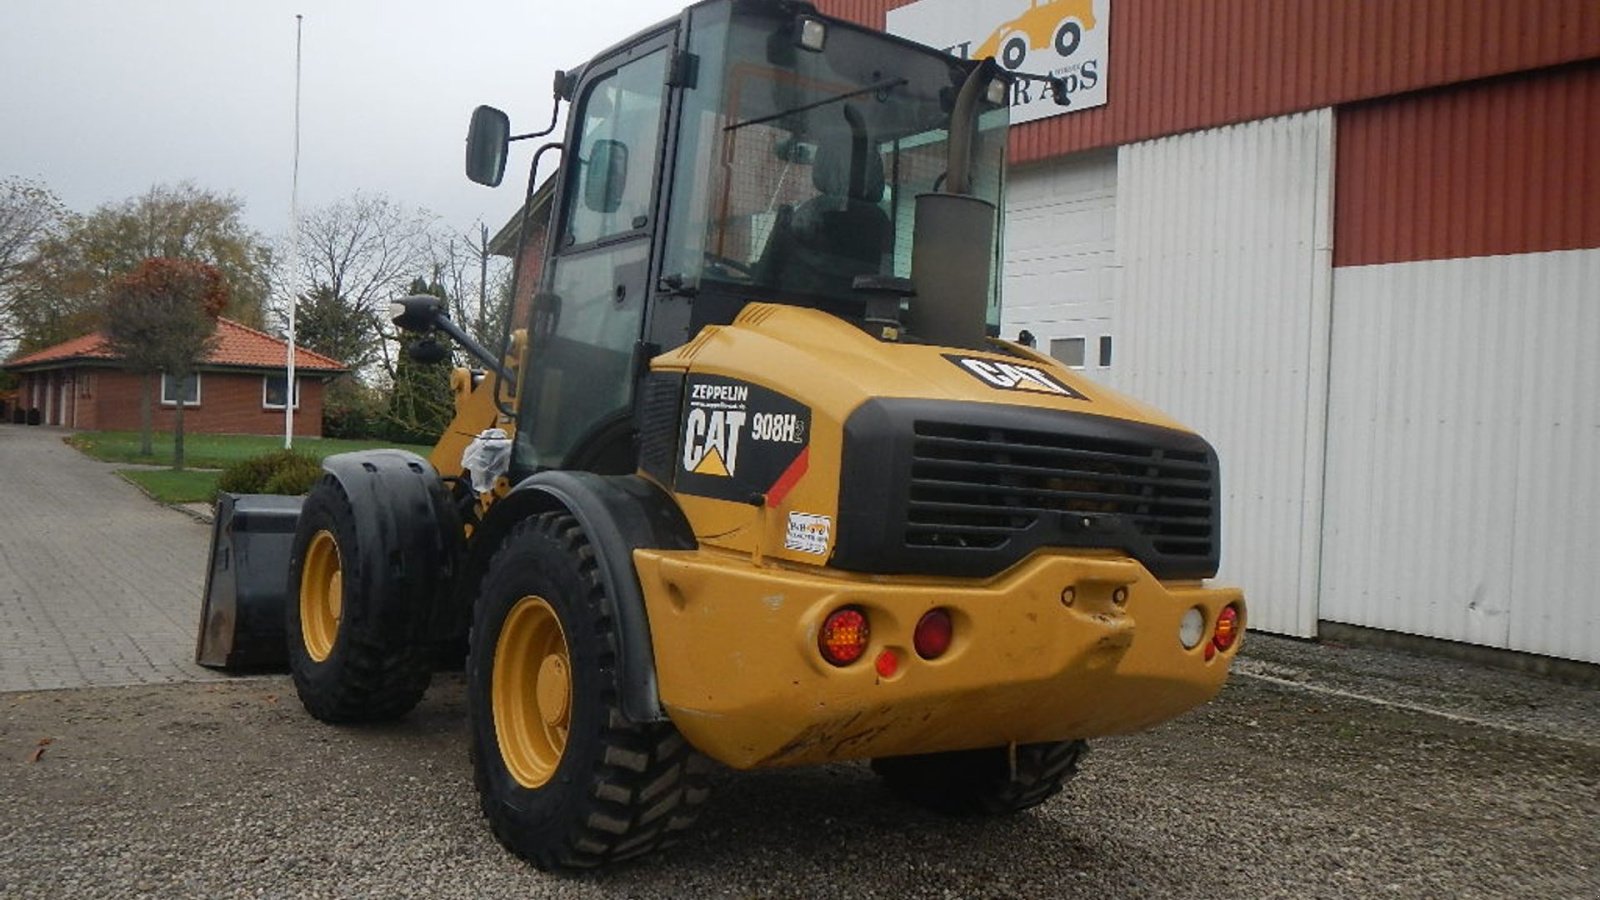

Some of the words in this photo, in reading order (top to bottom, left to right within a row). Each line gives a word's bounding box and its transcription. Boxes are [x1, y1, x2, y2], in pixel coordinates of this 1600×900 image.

[692, 384, 748, 401] ZEPPELIN
[960, 358, 1071, 396] CAT
[683, 408, 746, 477] CAT
